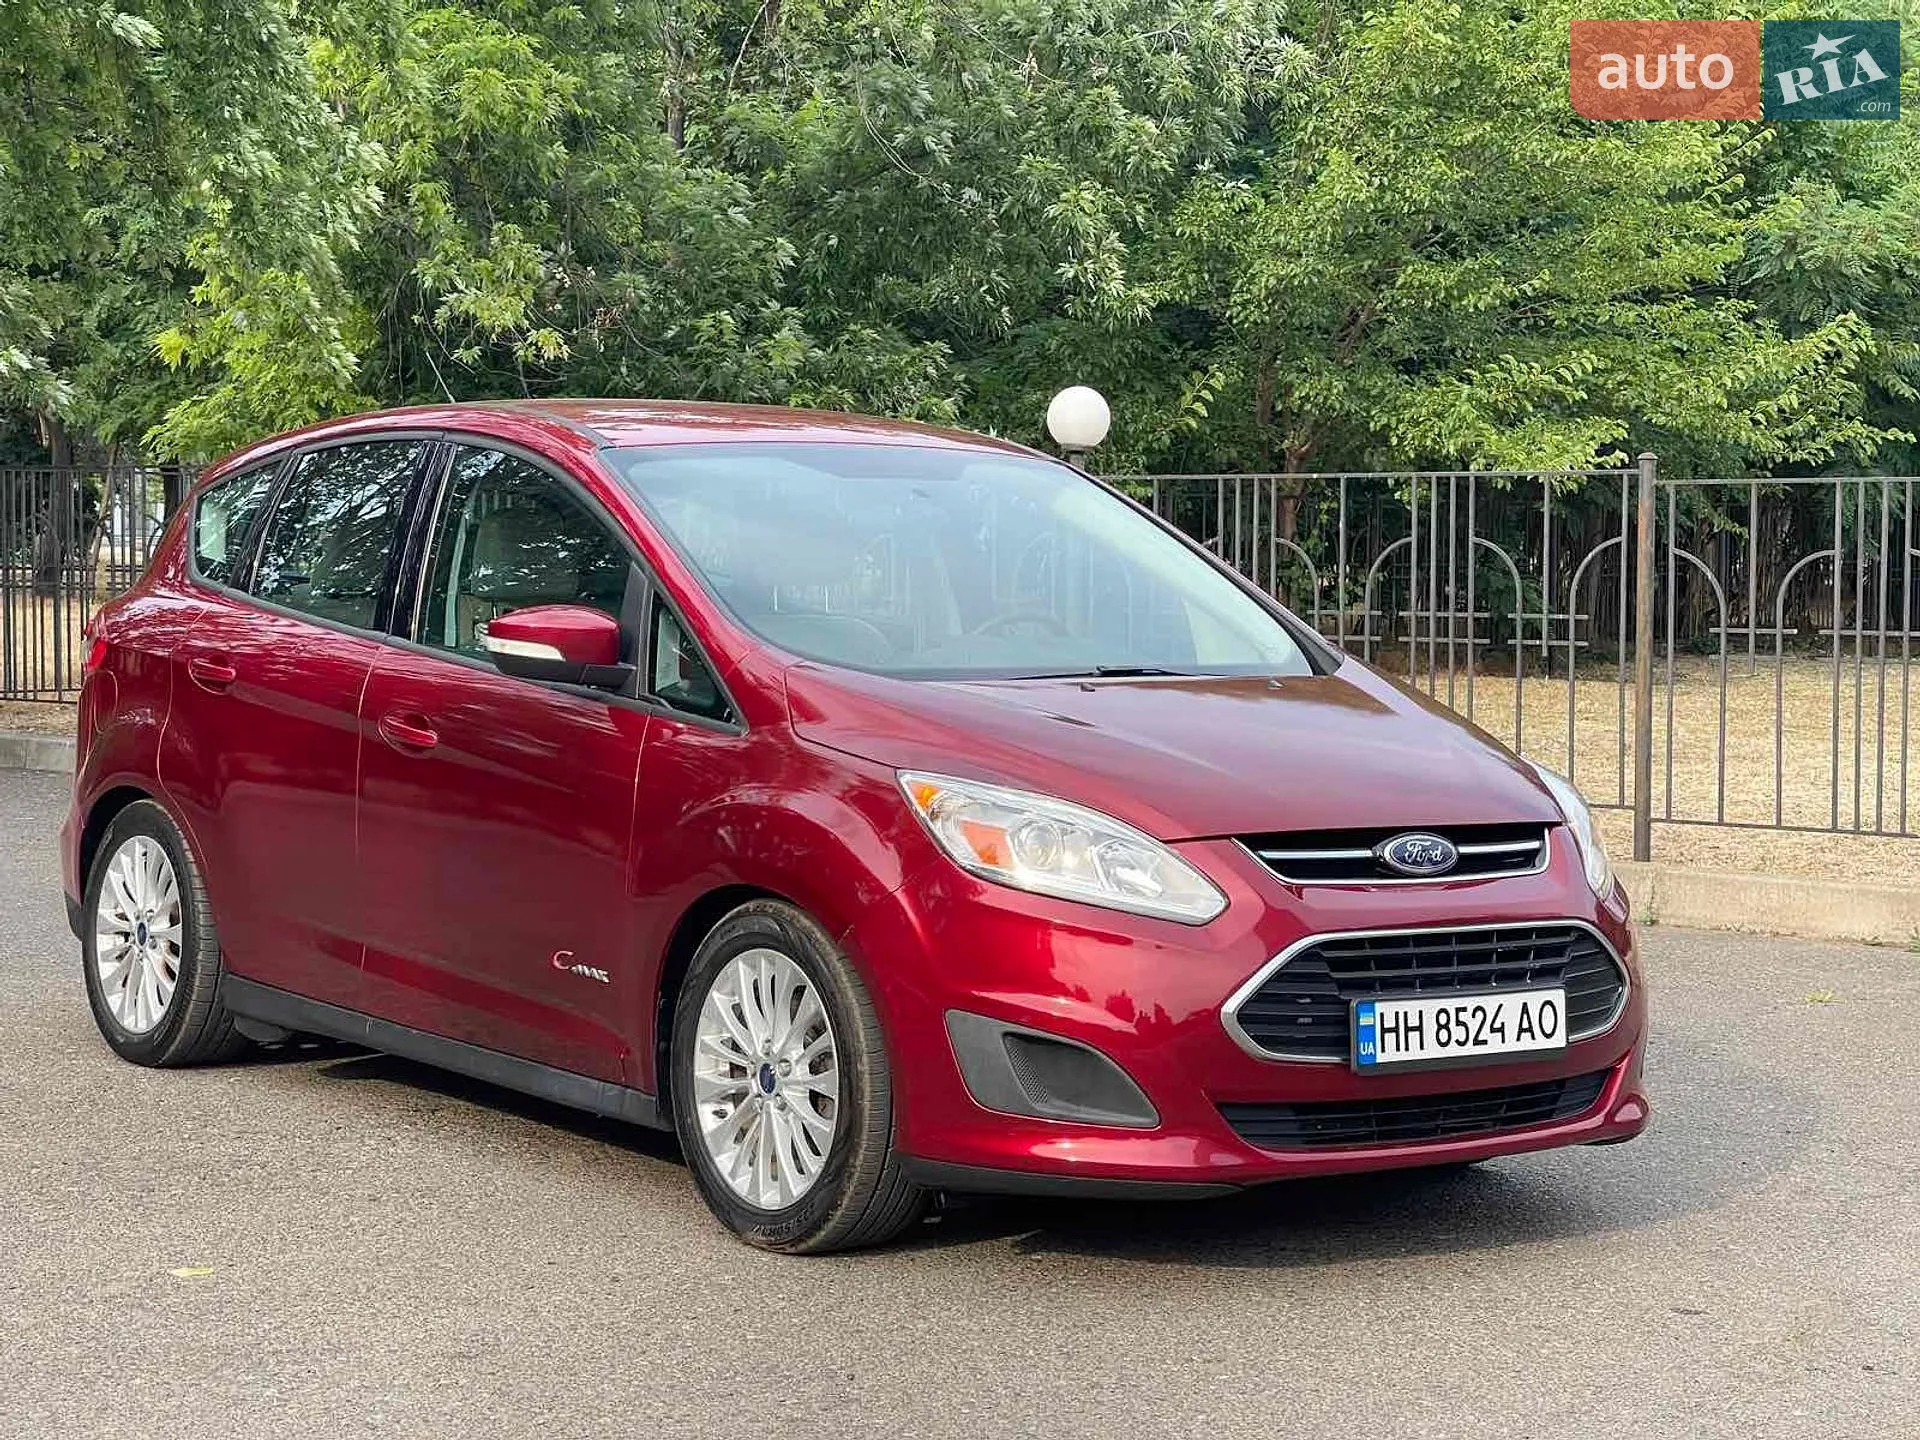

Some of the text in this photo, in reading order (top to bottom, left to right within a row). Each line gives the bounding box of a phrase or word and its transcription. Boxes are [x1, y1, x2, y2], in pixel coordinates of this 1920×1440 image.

[1405, 840, 1443, 863] Ford
[1379, 999, 1558, 1054] HH 8524 AO
[1360, 1041, 1375, 1056] UA
